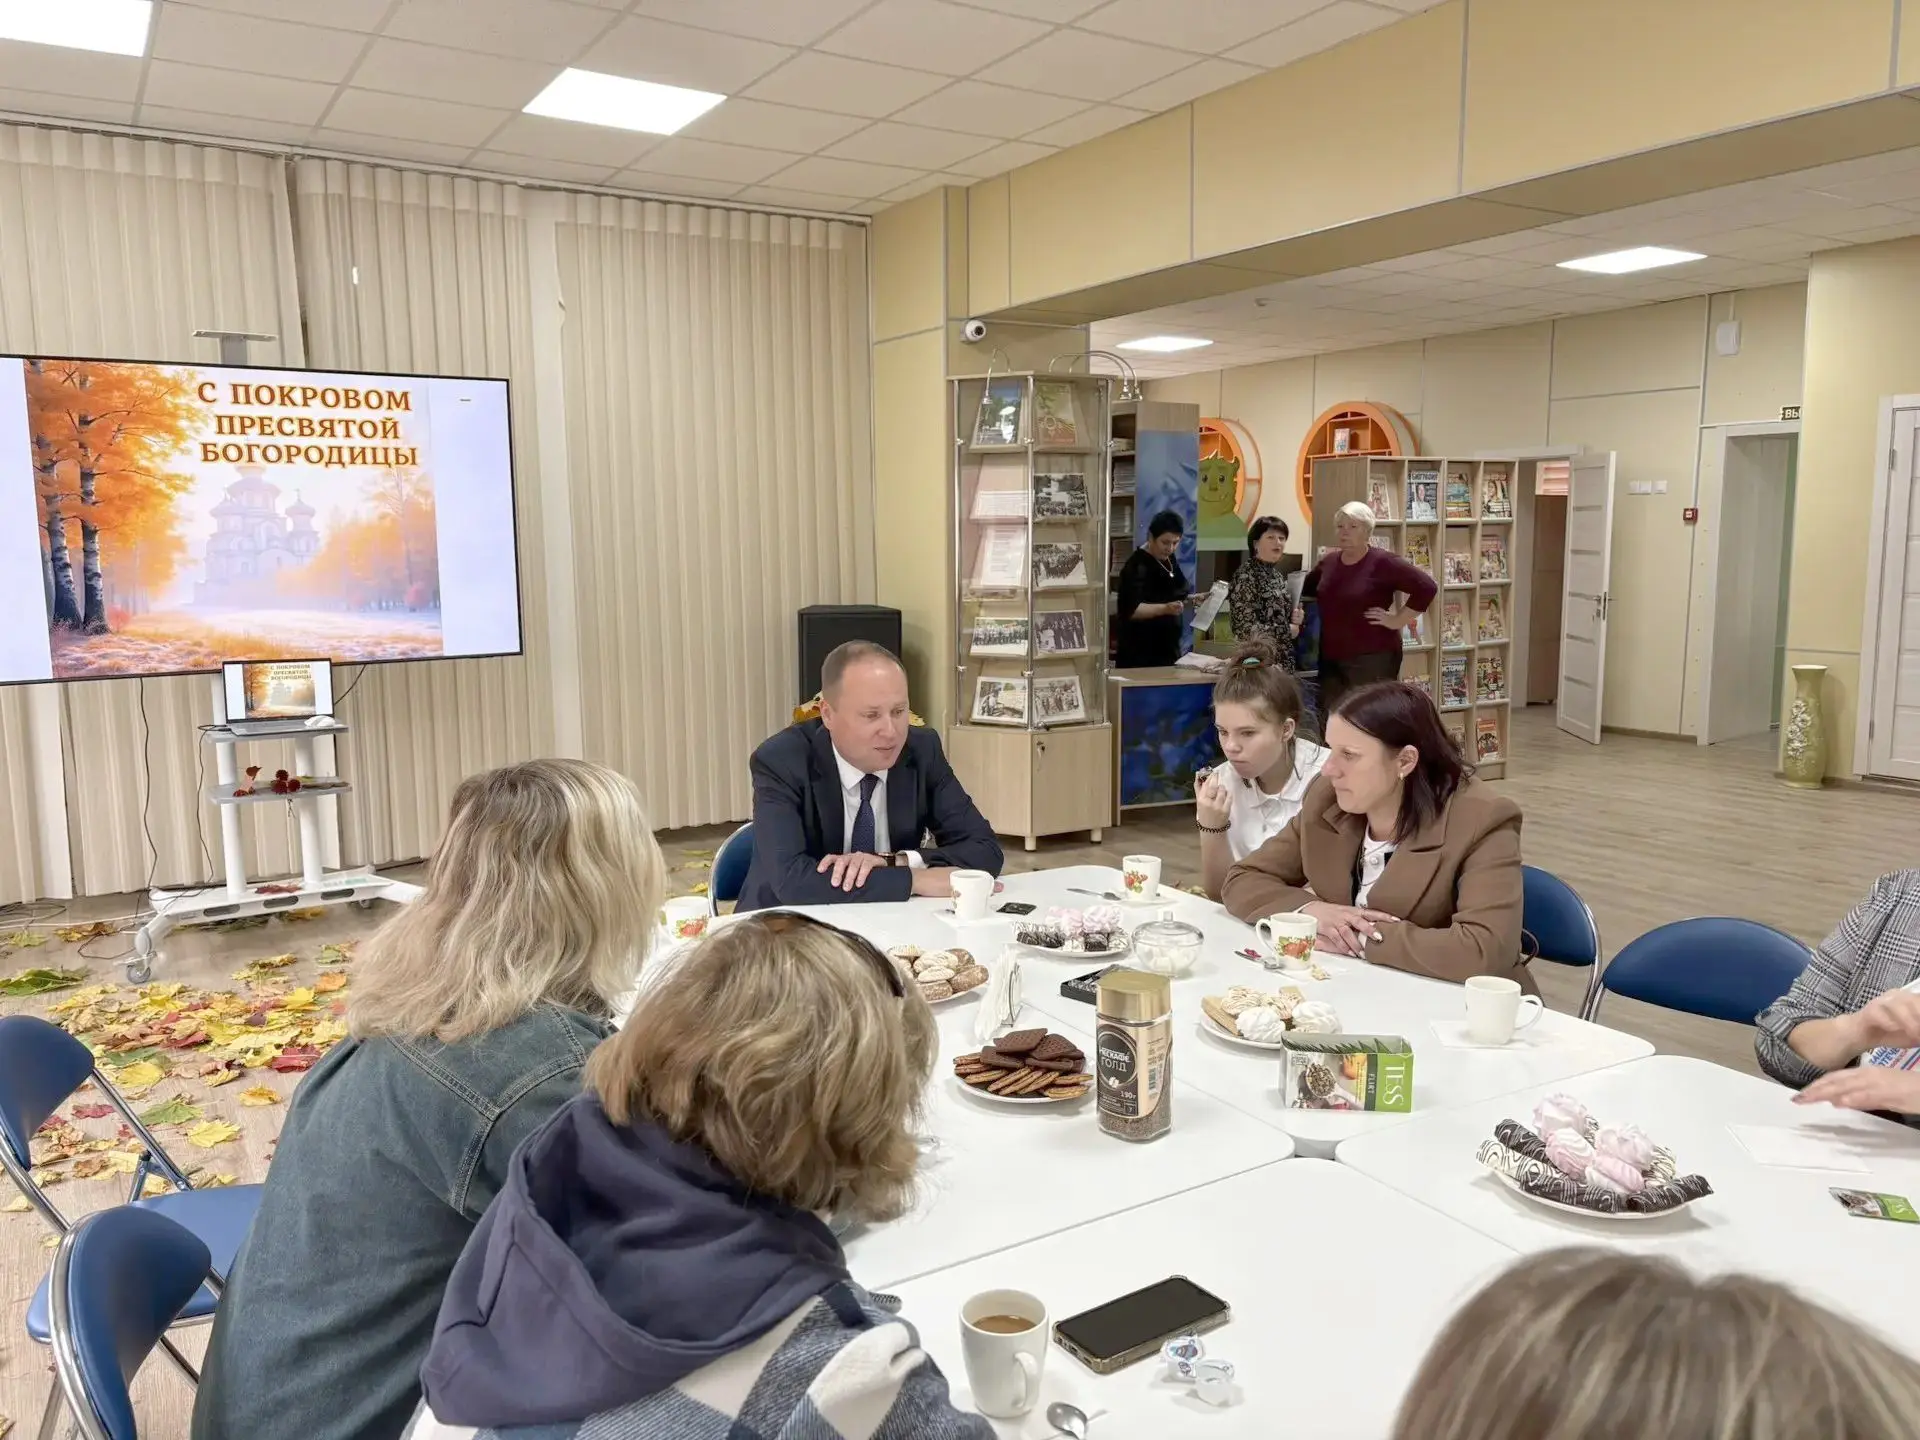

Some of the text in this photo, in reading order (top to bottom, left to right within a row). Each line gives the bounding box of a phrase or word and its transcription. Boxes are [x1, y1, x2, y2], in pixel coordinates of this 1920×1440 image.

[198, 382, 412, 411] С ПОКРОВОМ
[215, 415, 400, 439] ПРЕСВЯТОЙ
[200, 442, 418, 468] БОГОРОДИЦЫ
[1101, 1057, 1127, 1072] ГОЛД
[1383, 1062, 1405, 1106] TESS
